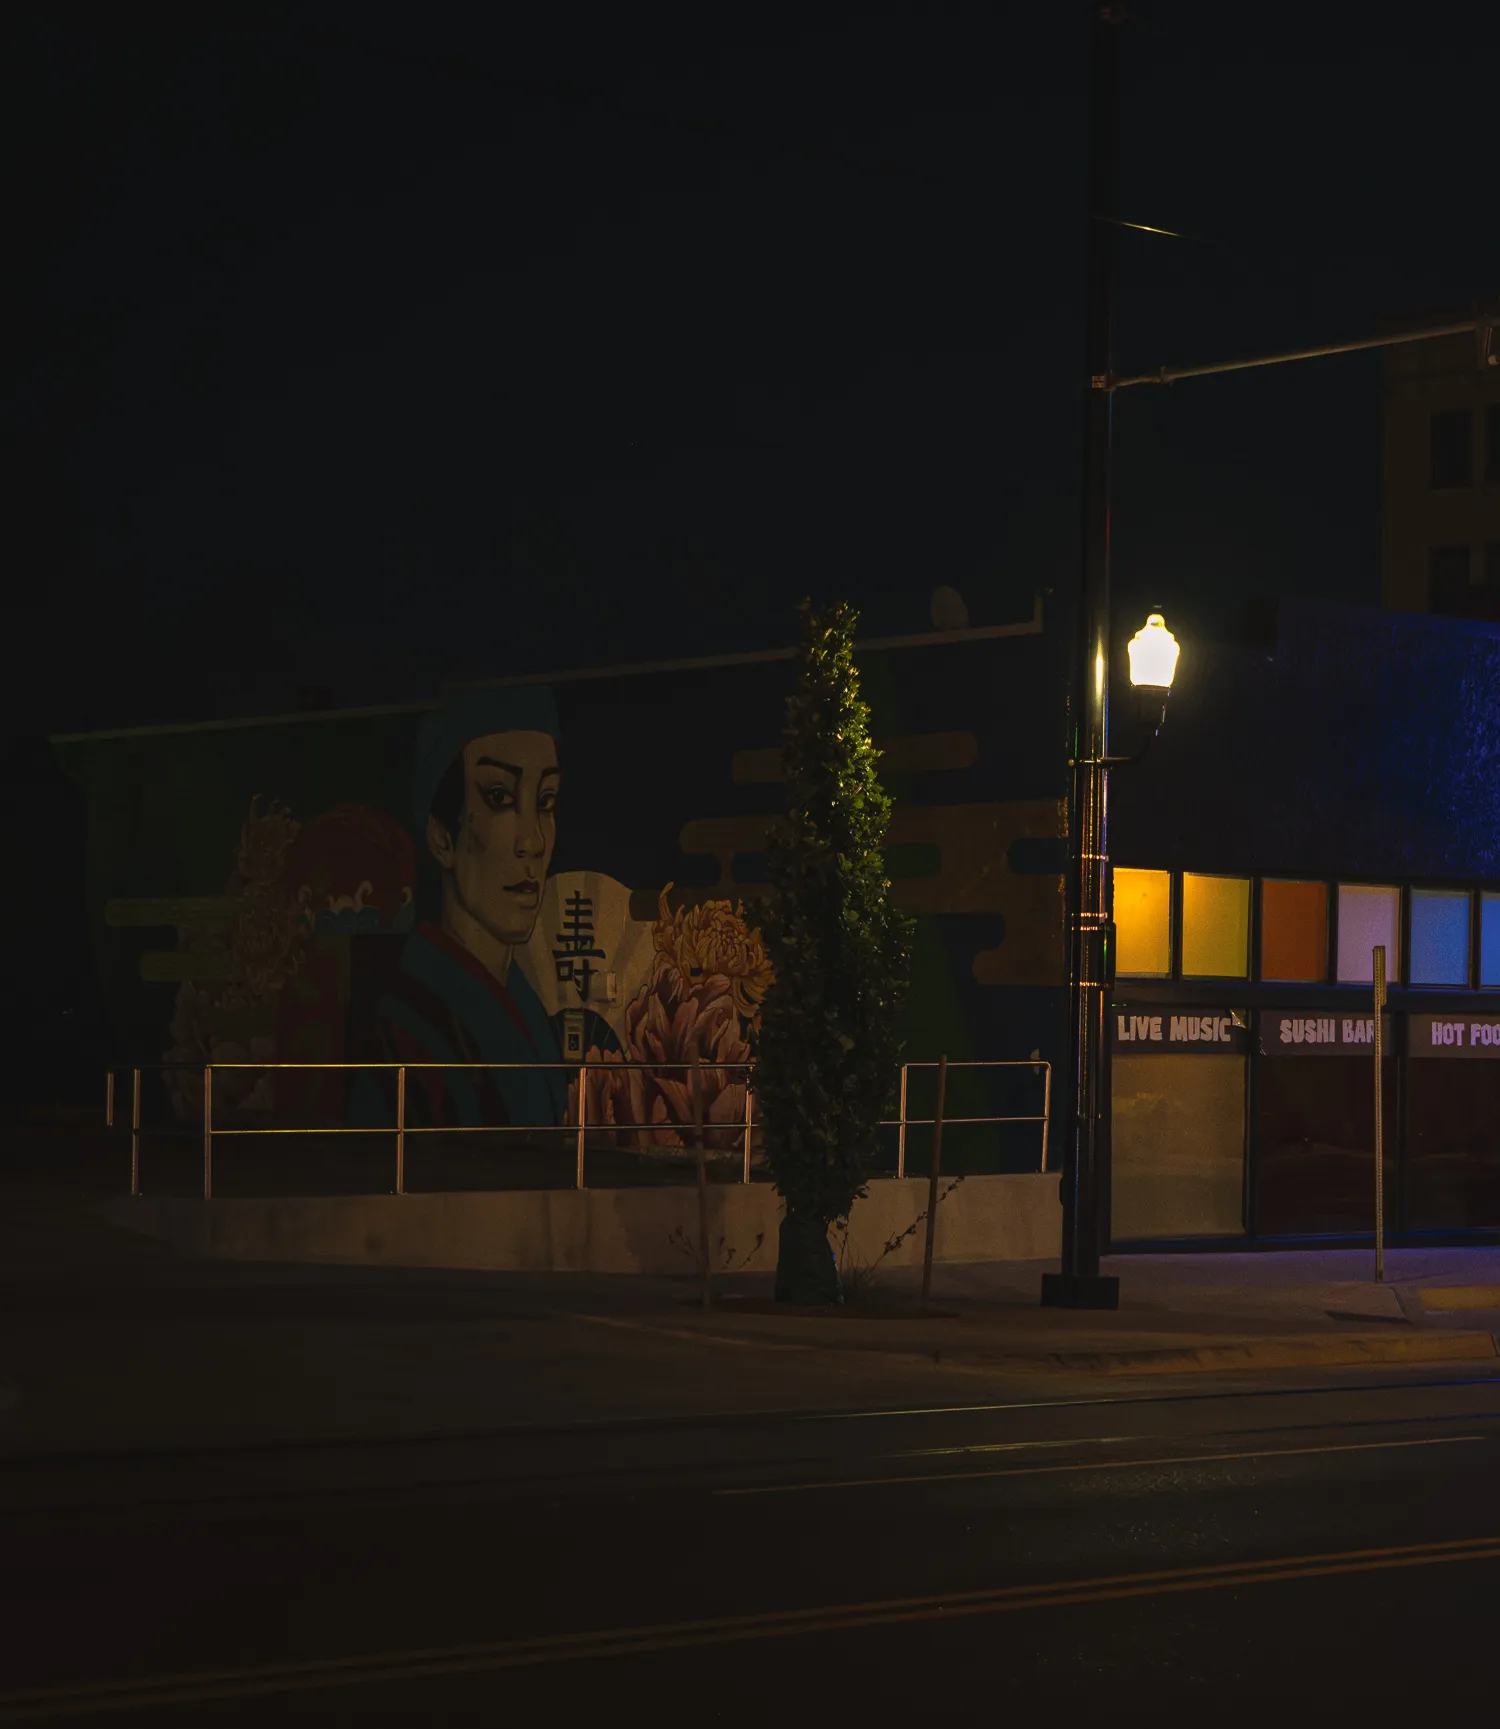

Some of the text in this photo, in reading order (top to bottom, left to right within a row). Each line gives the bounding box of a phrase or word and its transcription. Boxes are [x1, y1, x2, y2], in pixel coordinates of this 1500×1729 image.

[1117, 1015, 1232, 1043] LIVE MUSIC
[1279, 1018, 1375, 1044] SUSHI BAR
[1431, 1021, 1464, 1046] HOT
